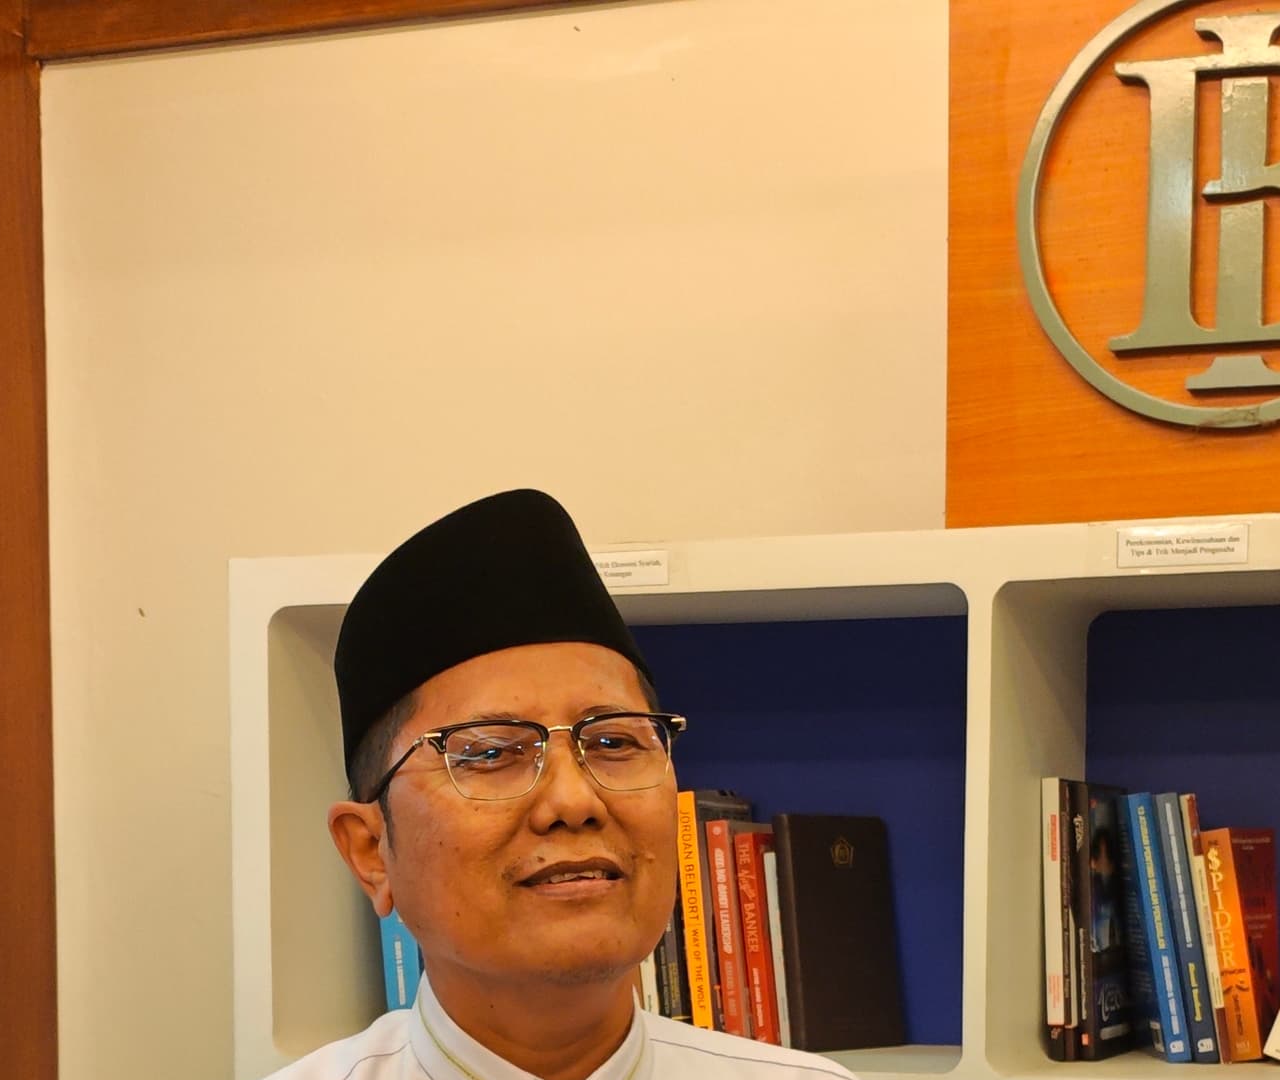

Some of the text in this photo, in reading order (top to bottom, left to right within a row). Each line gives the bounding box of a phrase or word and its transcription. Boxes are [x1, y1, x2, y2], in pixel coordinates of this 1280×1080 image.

[738, 841, 750, 864] THE
[678, 808, 705, 1011] JORDAN BELFORT WAY OF THE WOLF
[743, 902, 758, 953] BANKER
